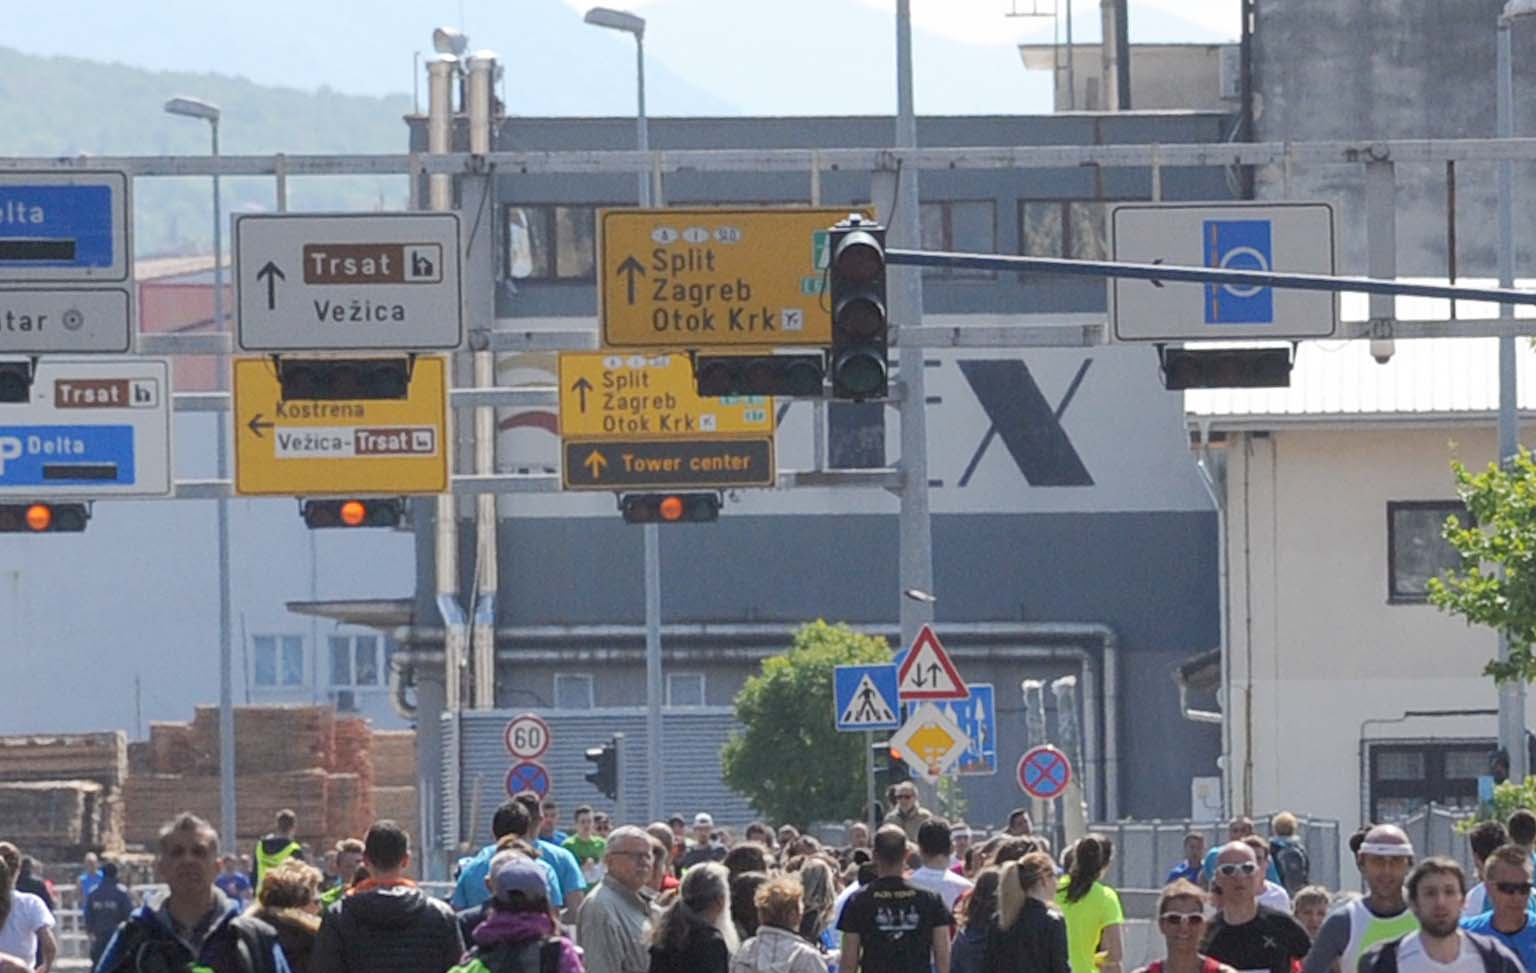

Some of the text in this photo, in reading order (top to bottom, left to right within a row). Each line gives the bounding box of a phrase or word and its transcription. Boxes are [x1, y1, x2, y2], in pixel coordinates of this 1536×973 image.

[0, 201, 45, 223] lta
[310, 253, 391, 275] Trsat
[652, 249, 716, 275] Split
[652, 278, 751, 308] Zagreb
[0, 310, 47, 332] tar
[314, 300, 405, 322] Vežica
[652, 308, 776, 332] Otok Krk
[602, 371, 649, 391] Split
[59, 384, 120, 403] Trsat
[602, 392, 677, 414] Zagreb
[275, 402, 365, 419] Kostrena
[603, 414, 695, 432] Otok Krk
[27, 436, 85, 454] Delta
[357, 432, 409, 450] Trsat
[622, 453, 752, 472] Tower center
[513, 727, 541, 748] 60
